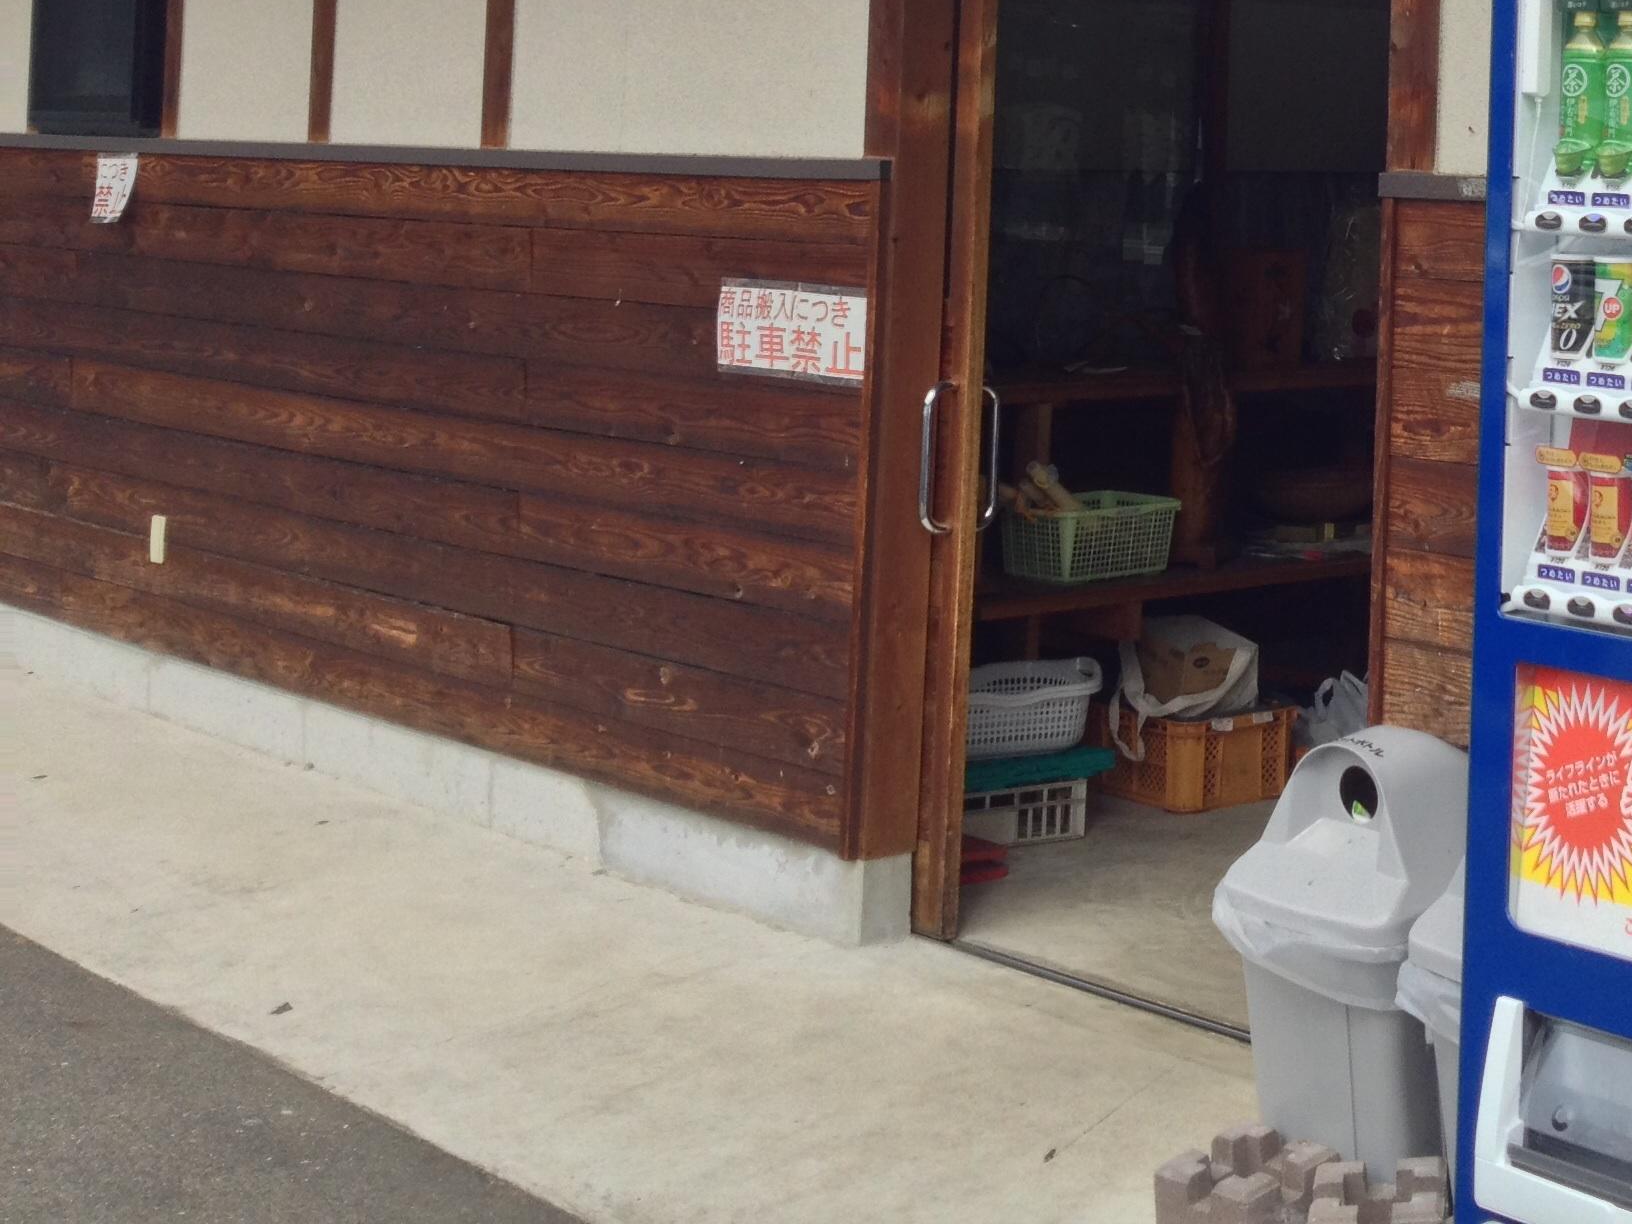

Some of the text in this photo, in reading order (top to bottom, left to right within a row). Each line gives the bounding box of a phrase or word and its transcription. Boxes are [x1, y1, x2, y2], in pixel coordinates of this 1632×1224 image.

[1595, 196, 1627, 207] つめたい
[720, 290, 851, 328] 商品搬入につき
[1604, 303, 1620, 314] UP
[719, 322, 865, 376] 駐車禁止
[1542, 570, 1572, 580] つめたい
[1545, 750, 1618, 785] ライフラインが
